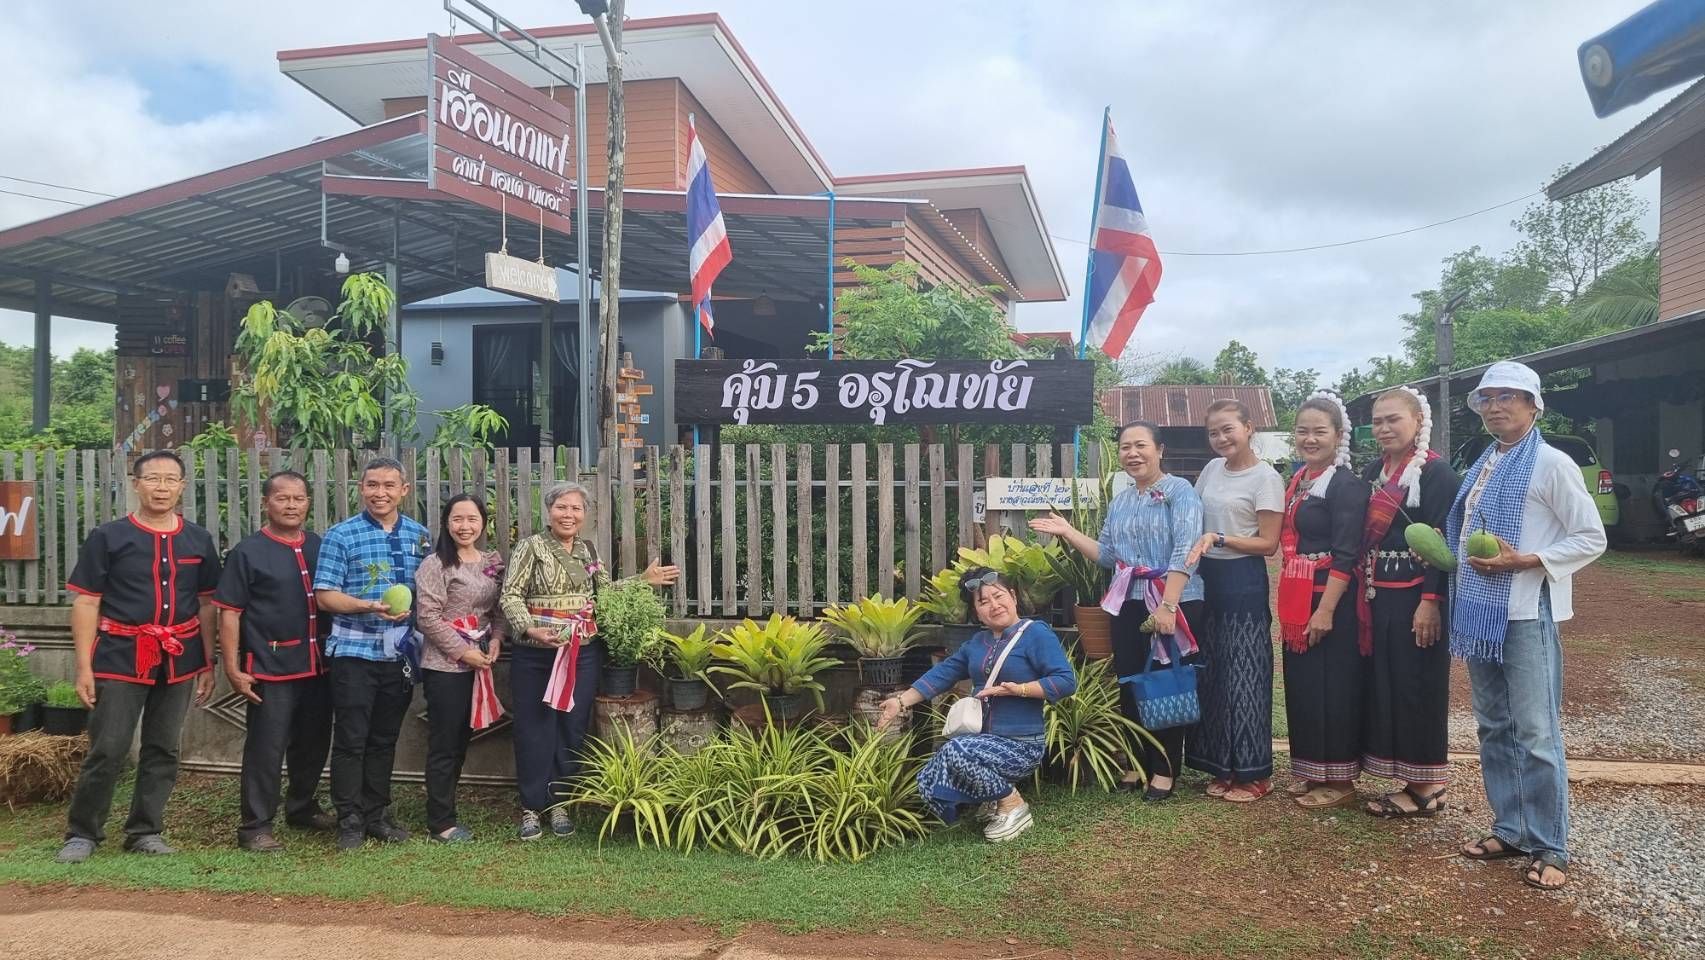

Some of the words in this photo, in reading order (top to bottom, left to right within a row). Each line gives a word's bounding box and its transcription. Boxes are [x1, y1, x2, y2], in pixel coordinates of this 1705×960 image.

[440, 70, 569, 176] เฮือนกาแฟ
[452, 154, 485, 182] คาเฟ่
[838, 359, 1035, 425] อรุโณทัย
